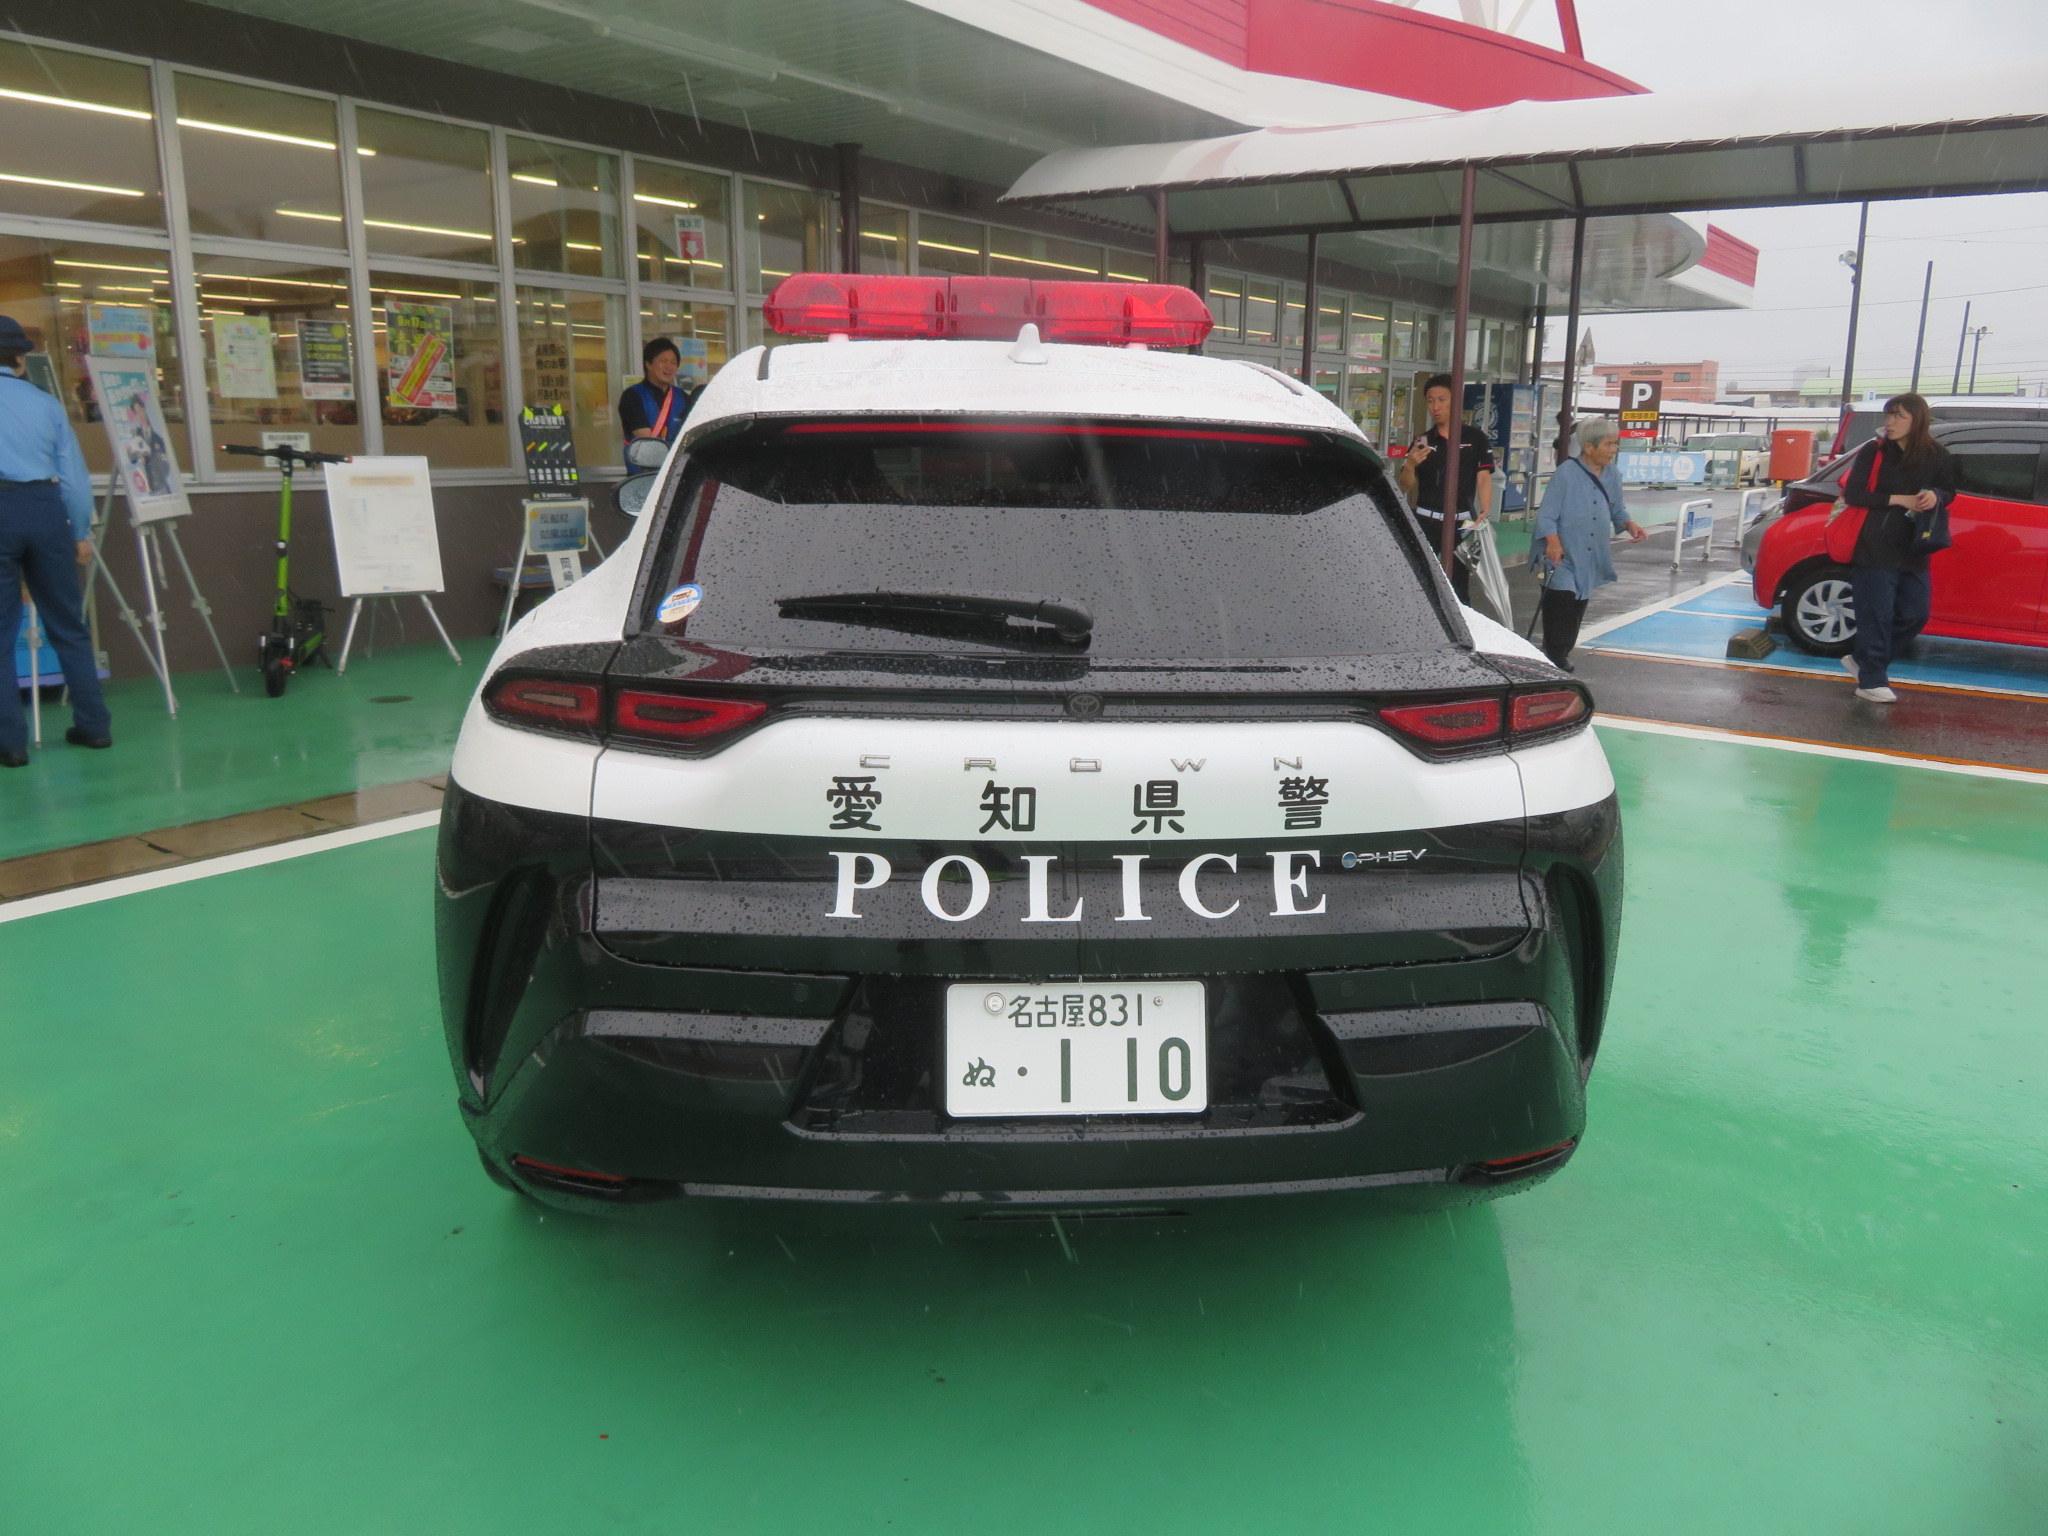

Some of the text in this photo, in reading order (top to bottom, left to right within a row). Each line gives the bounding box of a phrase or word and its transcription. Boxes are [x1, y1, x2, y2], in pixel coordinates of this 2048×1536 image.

[1631, 383, 1653, 409] P
[1628, 455, 1672, 467] 買取専門
[860, 754, 1303, 772] CROWN
[826, 775, 1329, 834] 愛知県警
[1357, 848, 1427, 865] PHEV
[824, 850, 1327, 922] POLICE
[962, 1057, 996, 1088] ぬ
